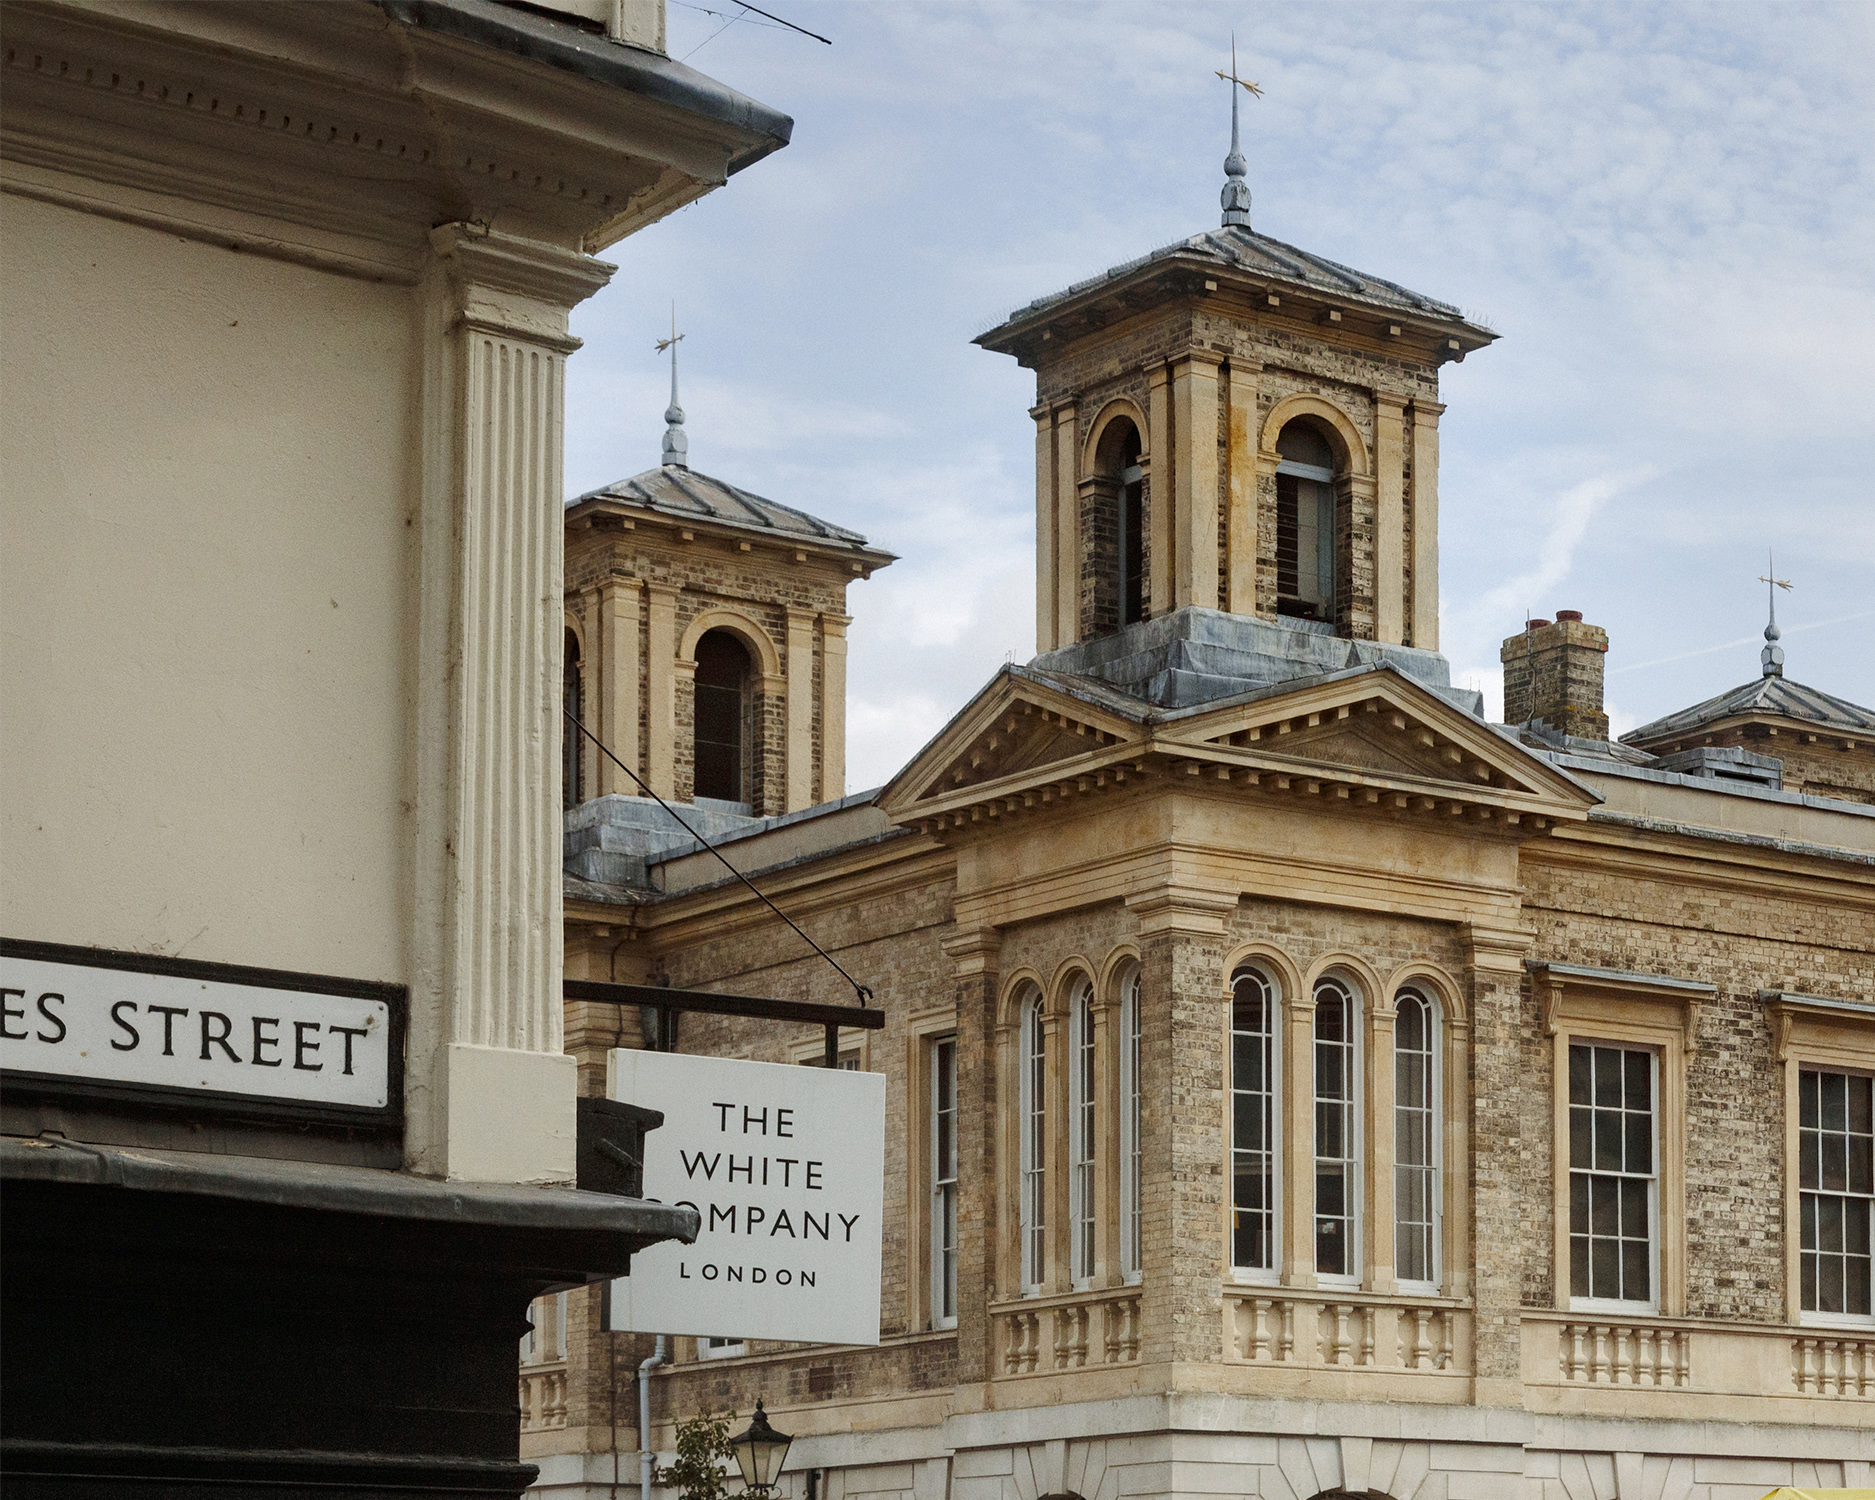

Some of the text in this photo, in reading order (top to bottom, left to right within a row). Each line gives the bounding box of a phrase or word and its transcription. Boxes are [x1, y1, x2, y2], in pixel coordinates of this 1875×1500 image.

[111, 1001, 369, 1076] STREET
[712, 1102, 794, 1138] THE
[680, 1150, 823, 1190] WHITE
[645, 1198, 860, 1242] MPANY
[680, 1262, 816, 1287] LONDON
